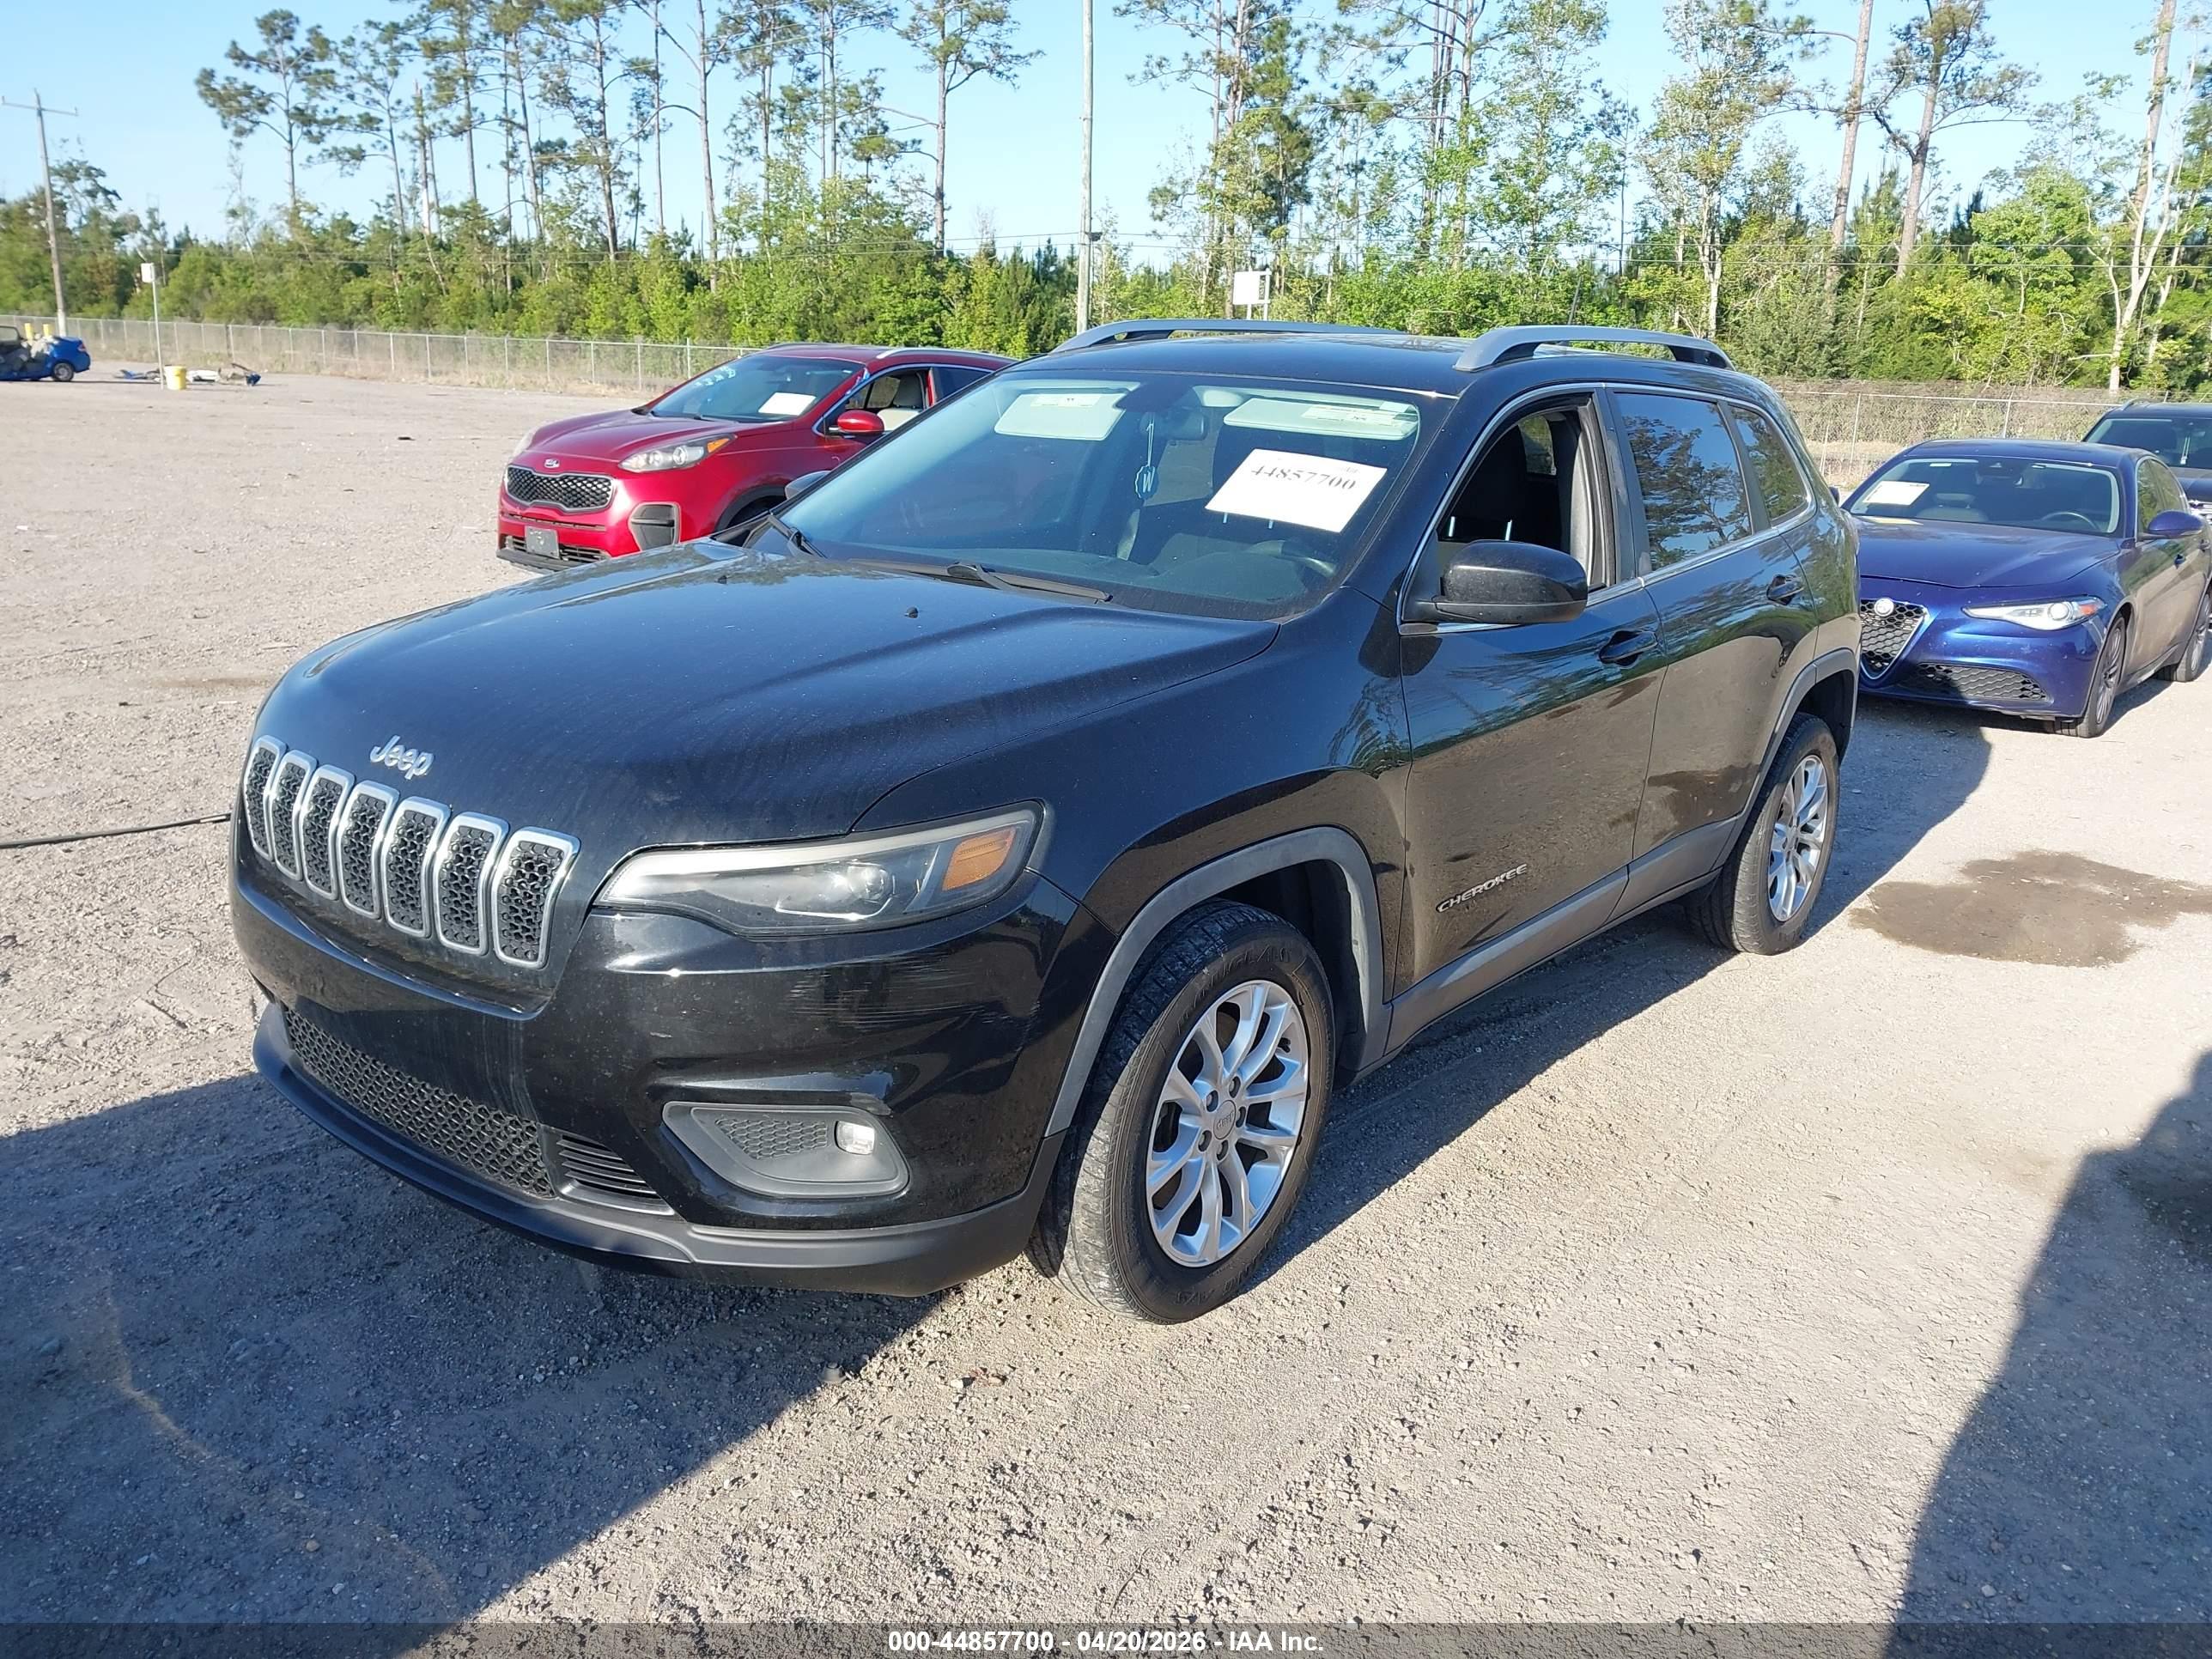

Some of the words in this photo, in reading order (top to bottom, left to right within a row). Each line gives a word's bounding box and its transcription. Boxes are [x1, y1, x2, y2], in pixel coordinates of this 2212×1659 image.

[1251, 465, 1357, 489] 44857700
[369, 734, 434, 780] Jeep
[1436, 863, 1528, 913] CHEROKEE
